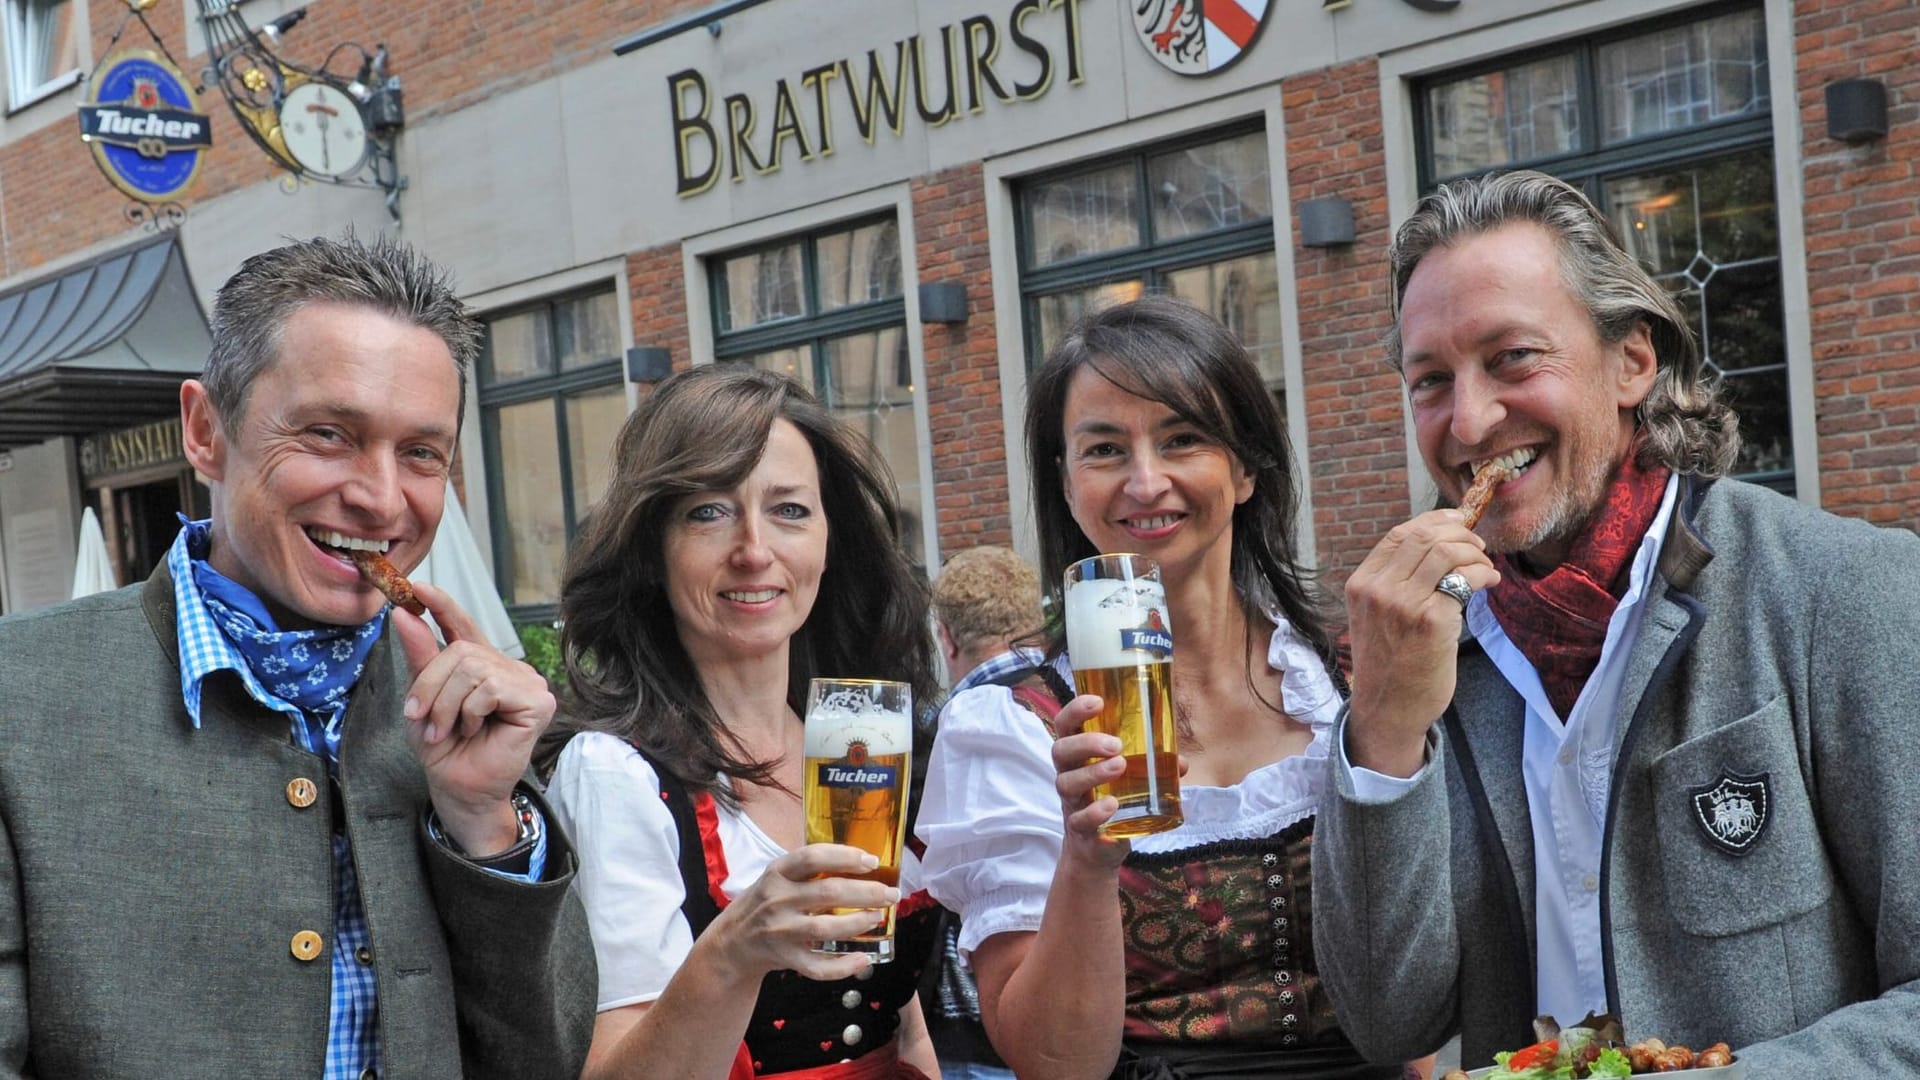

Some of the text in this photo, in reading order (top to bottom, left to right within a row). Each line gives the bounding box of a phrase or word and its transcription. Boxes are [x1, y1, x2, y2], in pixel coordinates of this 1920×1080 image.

[667, 0, 1089, 198] BRATWURST
[96, 109, 200, 139] Tucher
[827, 768, 888, 783] Tucher
